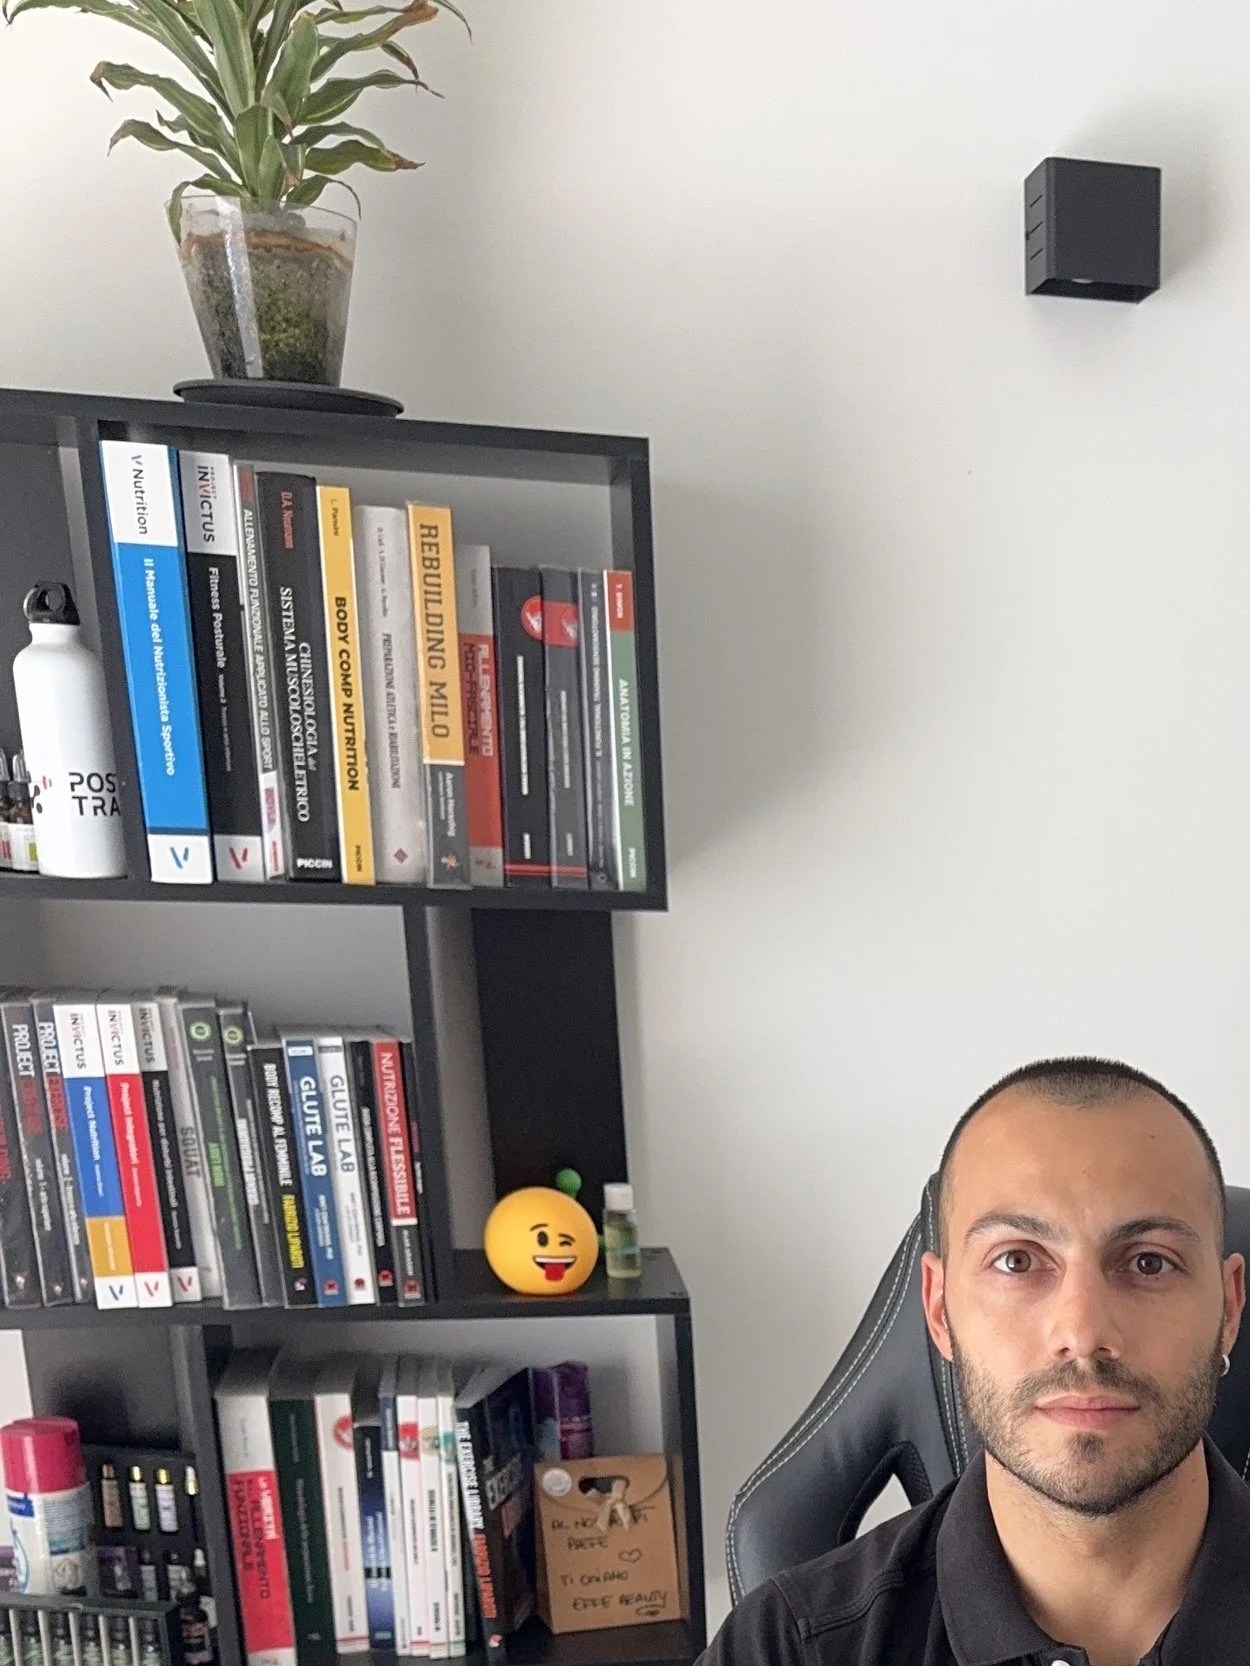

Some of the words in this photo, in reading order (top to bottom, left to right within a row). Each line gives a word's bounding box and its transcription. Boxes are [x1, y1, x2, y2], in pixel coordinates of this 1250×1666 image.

[132, 468, 149, 535] Nutrition
[197, 465, 215, 543] INVICTUS
[143, 557, 154, 567] Il
[243, 509, 258, 587] ALLENAMENTO
[145, 569, 159, 620] Manuale
[208, 567, 221, 610] Fitness
[419, 523, 447, 669] REBUILDING
[151, 623, 163, 643] del
[212, 612, 227, 668] Posturale
[249, 588, 263, 652] FUNZIONALE
[279, 586, 297, 651] SISTEMA
[335, 596, 349, 645] BODY
[153, 645, 169, 722] Nutrizionista
[254, 654, 268, 708] APPLICATO
[298, 641, 319, 755] CHINESIOLOGIA
[338, 648, 354, 698] COMP
[260, 709, 271, 736] ALLO
[429, 680, 450, 738] MILO
[478, 644, 494, 757] ALLENAMENTO
[617, 678, 633, 745] ANATOMIA
[160, 724, 176, 776] Sportivo
[261, 737, 273, 770] SPORT
[284, 652, 311, 822] MUSCOLOSCHELETRICO
[342, 702, 359, 791] NUTRITION
[622, 746, 632, 761] IN
[69, 771, 117, 793] POS
[72, 796, 122, 816] TRA
[622, 761, 635, 807] AZIONE
[296, 857, 334, 869] PICCIN
[12, 1024, 34, 1078] PROJECT
[38, 1021, 61, 1074] PROJECT
[69, 1012, 86, 1069] INVICTUS
[107, 1009, 124, 1066] INVICTUS
[139, 1007, 156, 1064] INVICTUS
[82, 1085, 96, 1118] Project
[119, 1082, 133, 1115] Project
[262, 1063, 279, 1088] BODY
[379, 1051, 401, 1134] NUTRIZIONE
[265, 1088, 283, 1125] RECOMP
[299, 1075, 321, 1136] GLUTE
[329, 1074, 350, 1133] GLUTE
[88, 1119, 101, 1160] Nutrition
[180, 1125, 201, 1178] SQUAT
[272, 1125, 285, 1138] AL
[337, 1138, 356, 1173] LAB
[274, 1138, 294, 1187] FEMMINILE
[307, 1139, 328, 1177] LAB
[388, 1136, 411, 1215] FLESSIBILE
[455, 1421, 470, 1440] THE
[457, 1441, 479, 1489] EXERCISE
[463, 1489, 485, 1530] LIBRARY
